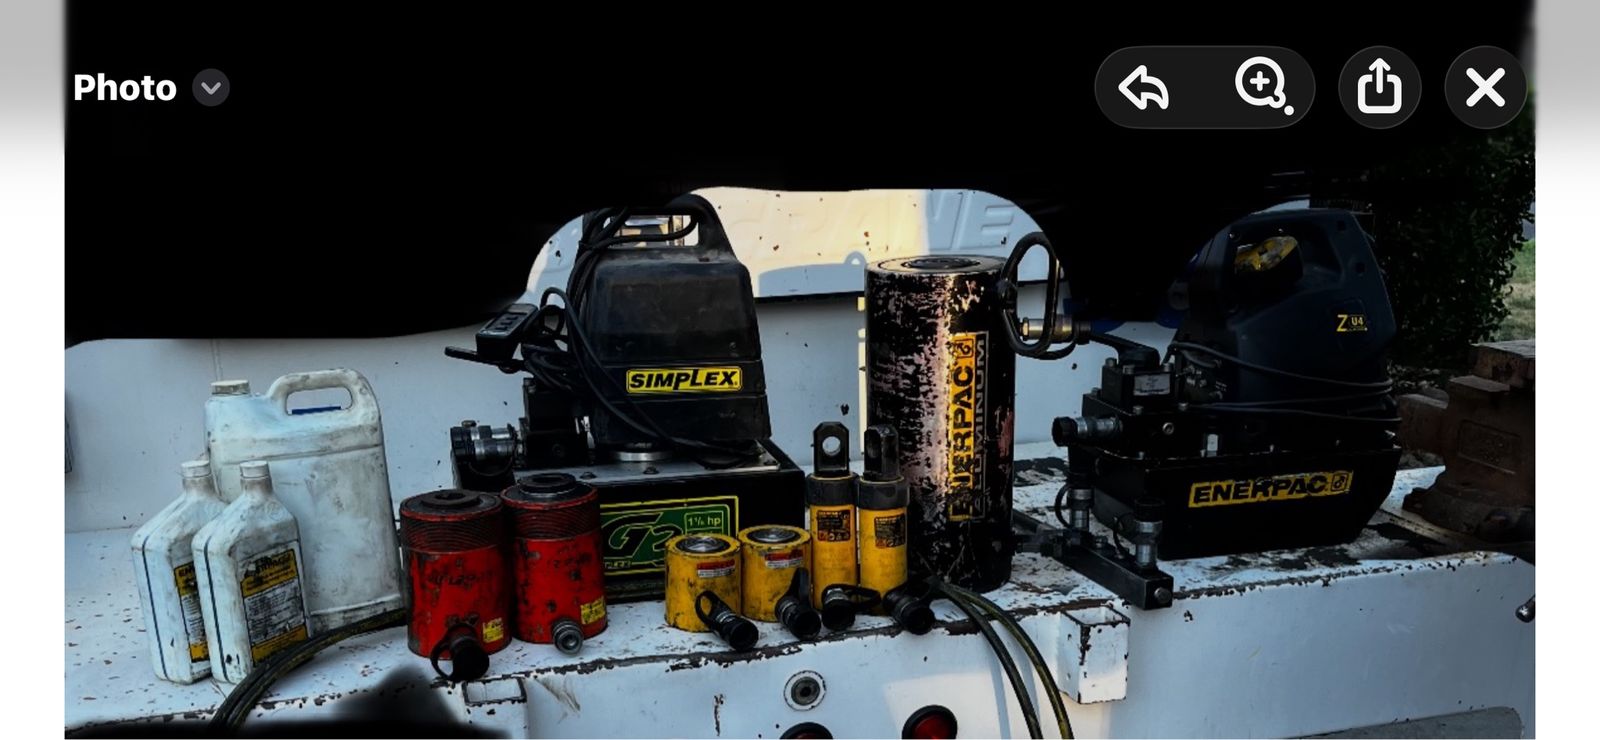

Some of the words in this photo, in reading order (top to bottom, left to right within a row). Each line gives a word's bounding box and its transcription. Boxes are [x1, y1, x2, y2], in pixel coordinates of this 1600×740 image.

[630, 369, 737, 390] SIMPLEX
[952, 365, 972, 516] ENERPAC
[1193, 474, 1327, 504] ENERPAC
[707, 515, 721, 527] hp
